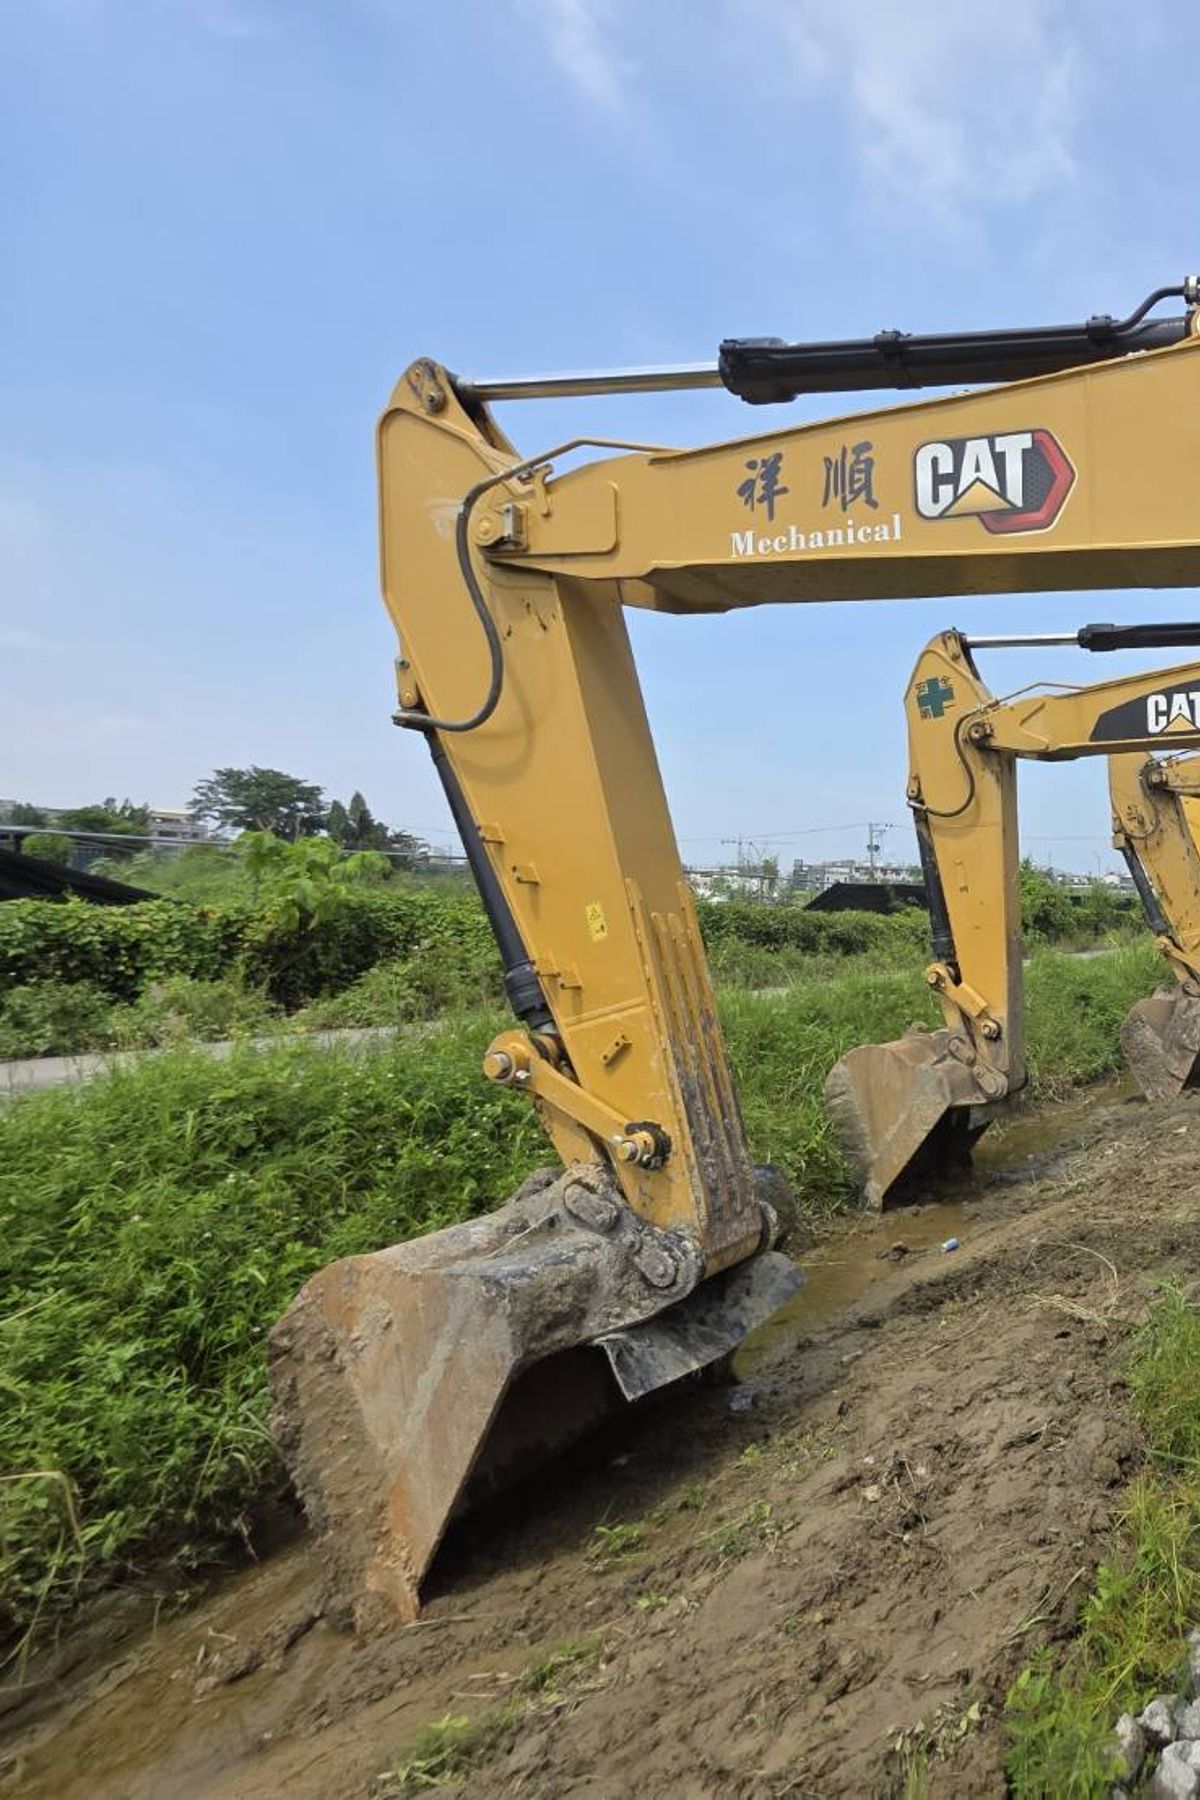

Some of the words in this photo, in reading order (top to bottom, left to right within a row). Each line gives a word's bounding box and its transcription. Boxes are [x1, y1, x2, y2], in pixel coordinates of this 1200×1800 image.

[737, 441, 879, 521] 祥順
[915, 432, 1032, 518] CAT
[731, 514, 901, 557] Mechanical
